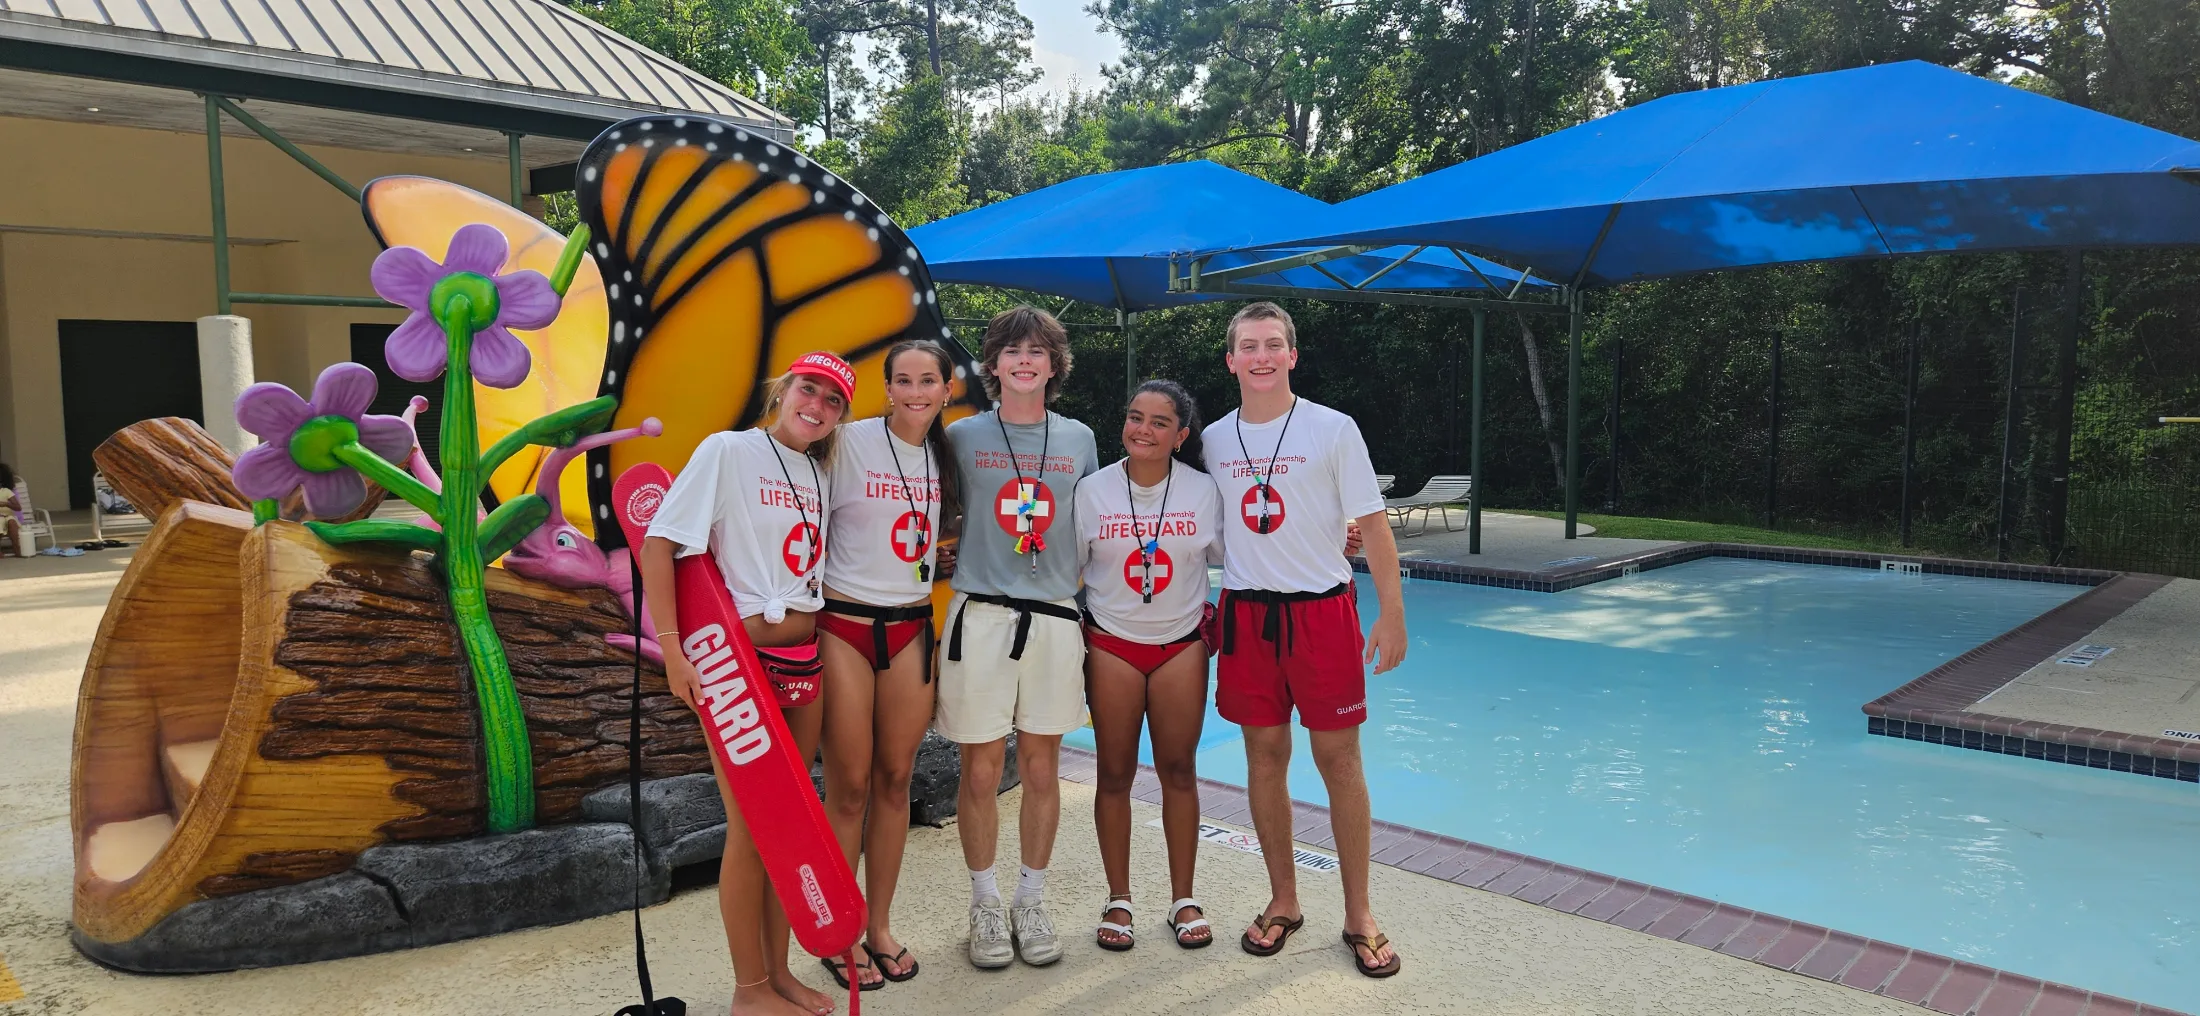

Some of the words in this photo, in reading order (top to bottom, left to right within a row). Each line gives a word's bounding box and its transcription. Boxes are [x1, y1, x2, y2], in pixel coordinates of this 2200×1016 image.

[803, 354, 855, 387] LIFEGUARD
[975, 450, 989, 458] The
[992, 451, 1037, 461] Woodlands
[1040, 454, 1074, 464] Township
[1275, 454, 1307, 464] ownship
[975, 459, 1008, 469] HEAD
[1012, 461, 1075, 474] LIFEGUARD
[1232, 464, 1289, 478] LIFEGUARD
[759, 476, 773, 486] The
[866, 470, 882, 479] The
[641, 483, 667, 497] LIFEGUAR
[866, 481, 941, 504] LIFEGUAR
[760, 488, 823, 518] LIFEGUA
[1099, 514, 1112, 522] The
[1098, 520, 1197, 540] LIFEGUARD
[779, 681, 814, 691] UARD
[682, 623, 772, 766] GUARD
[1336, 702, 1363, 715] GUARD
[2164, 730, 2200, 740] VING
[801, 867, 831, 923] EXOTUBE
